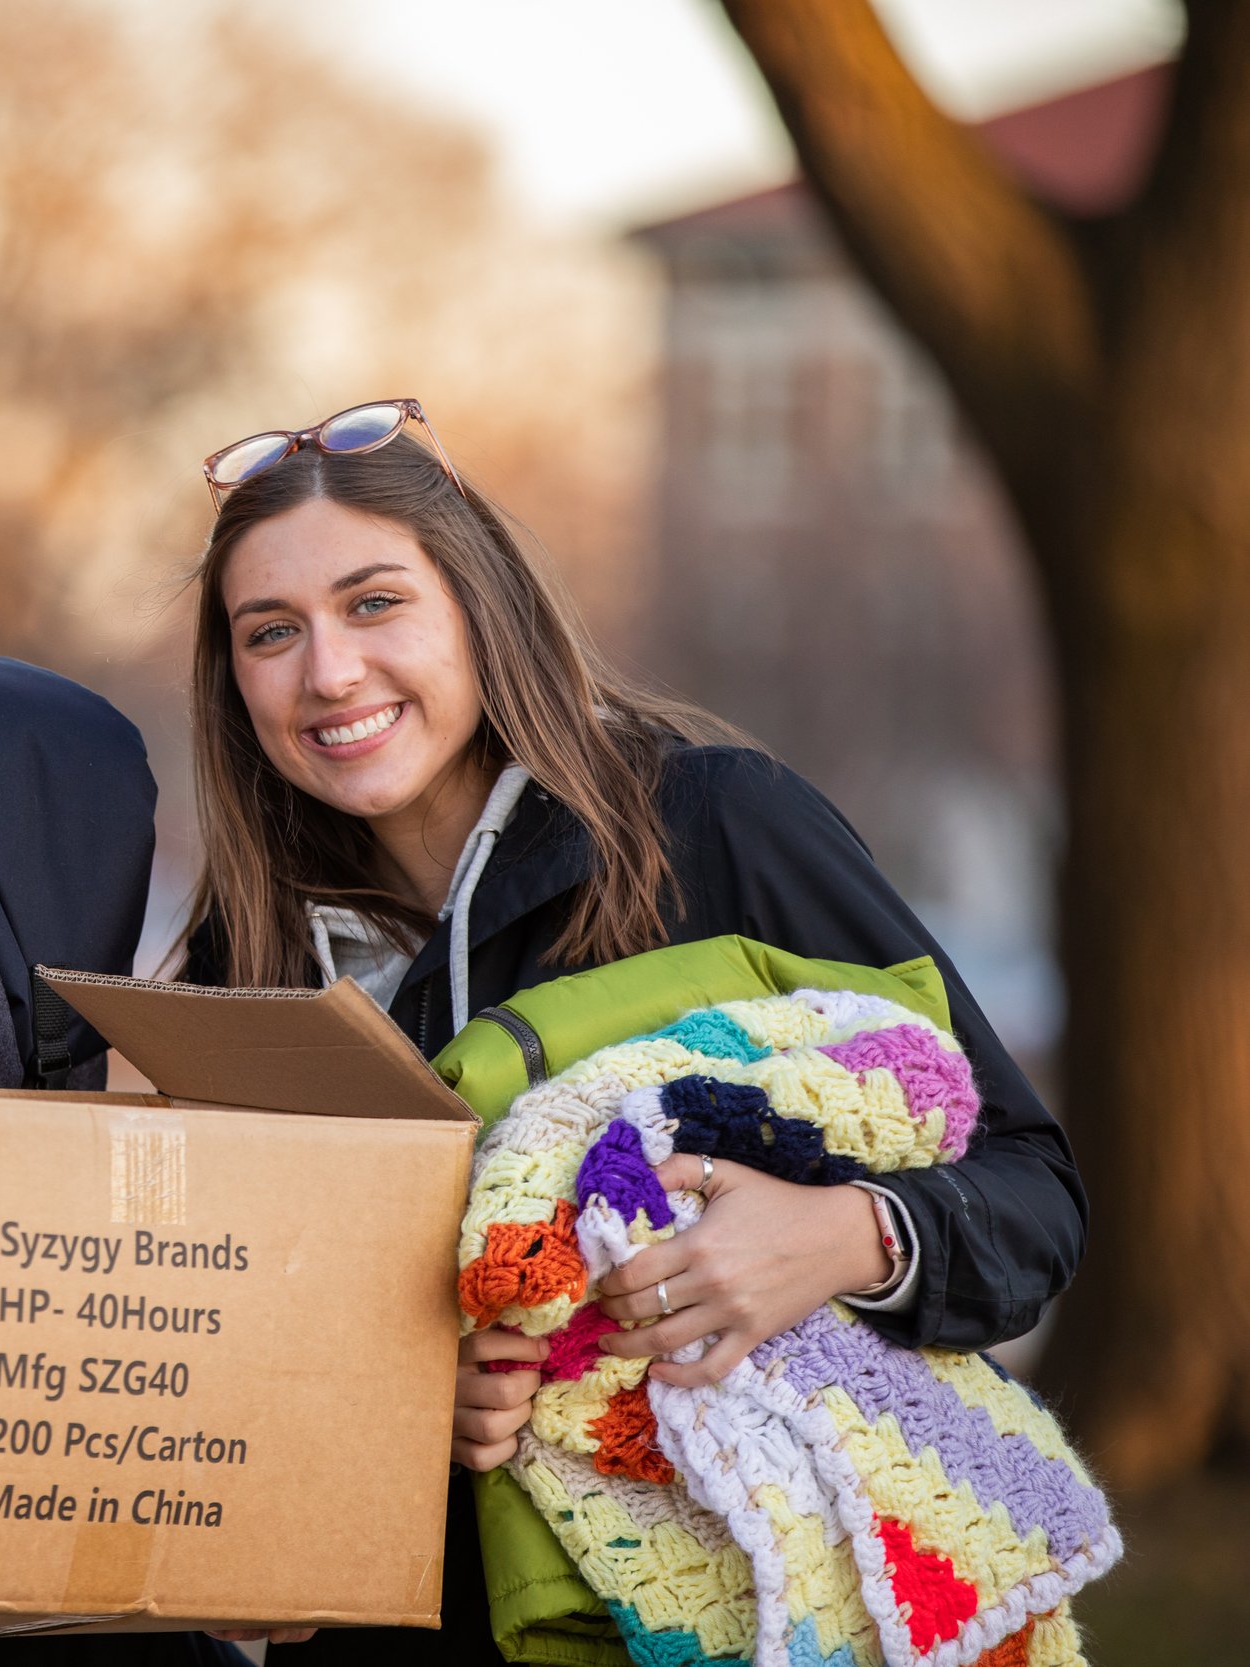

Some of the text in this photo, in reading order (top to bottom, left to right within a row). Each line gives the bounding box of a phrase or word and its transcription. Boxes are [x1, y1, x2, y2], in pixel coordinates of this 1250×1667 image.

[0, 1221, 248, 1274] Syzygy Brands
[0, 1287, 222, 1335] HP- 40Hours
[78, 1357, 189, 1398] SZG40
[63, 1422, 248, 1465] Pcs/Carton
[87, 1486, 119, 1524] in
[131, 1489, 223, 1527] China
